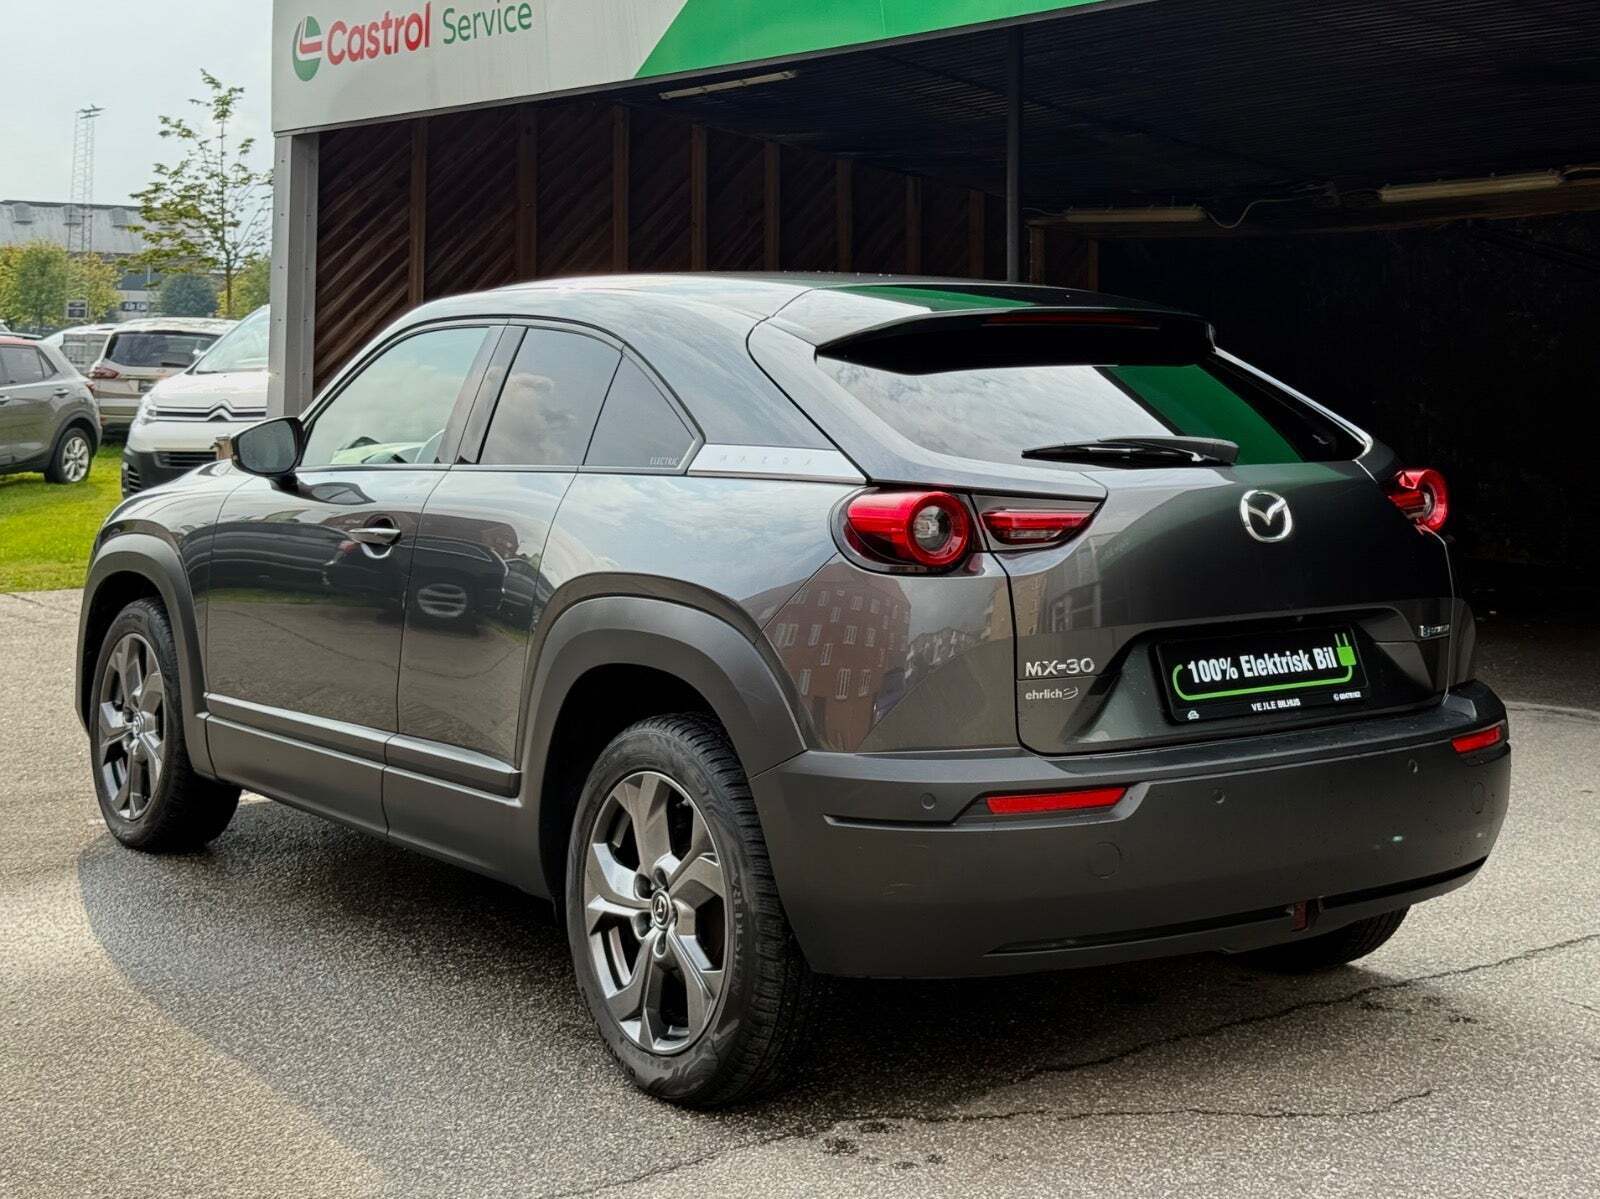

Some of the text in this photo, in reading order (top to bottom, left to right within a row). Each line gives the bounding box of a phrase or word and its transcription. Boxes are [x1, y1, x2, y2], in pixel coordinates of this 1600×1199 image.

[327, 0, 532, 65] Castrol Service
[1025, 657, 1096, 677] MX-30
[1187, 646, 1338, 684] 100% Elektrisk Bil
